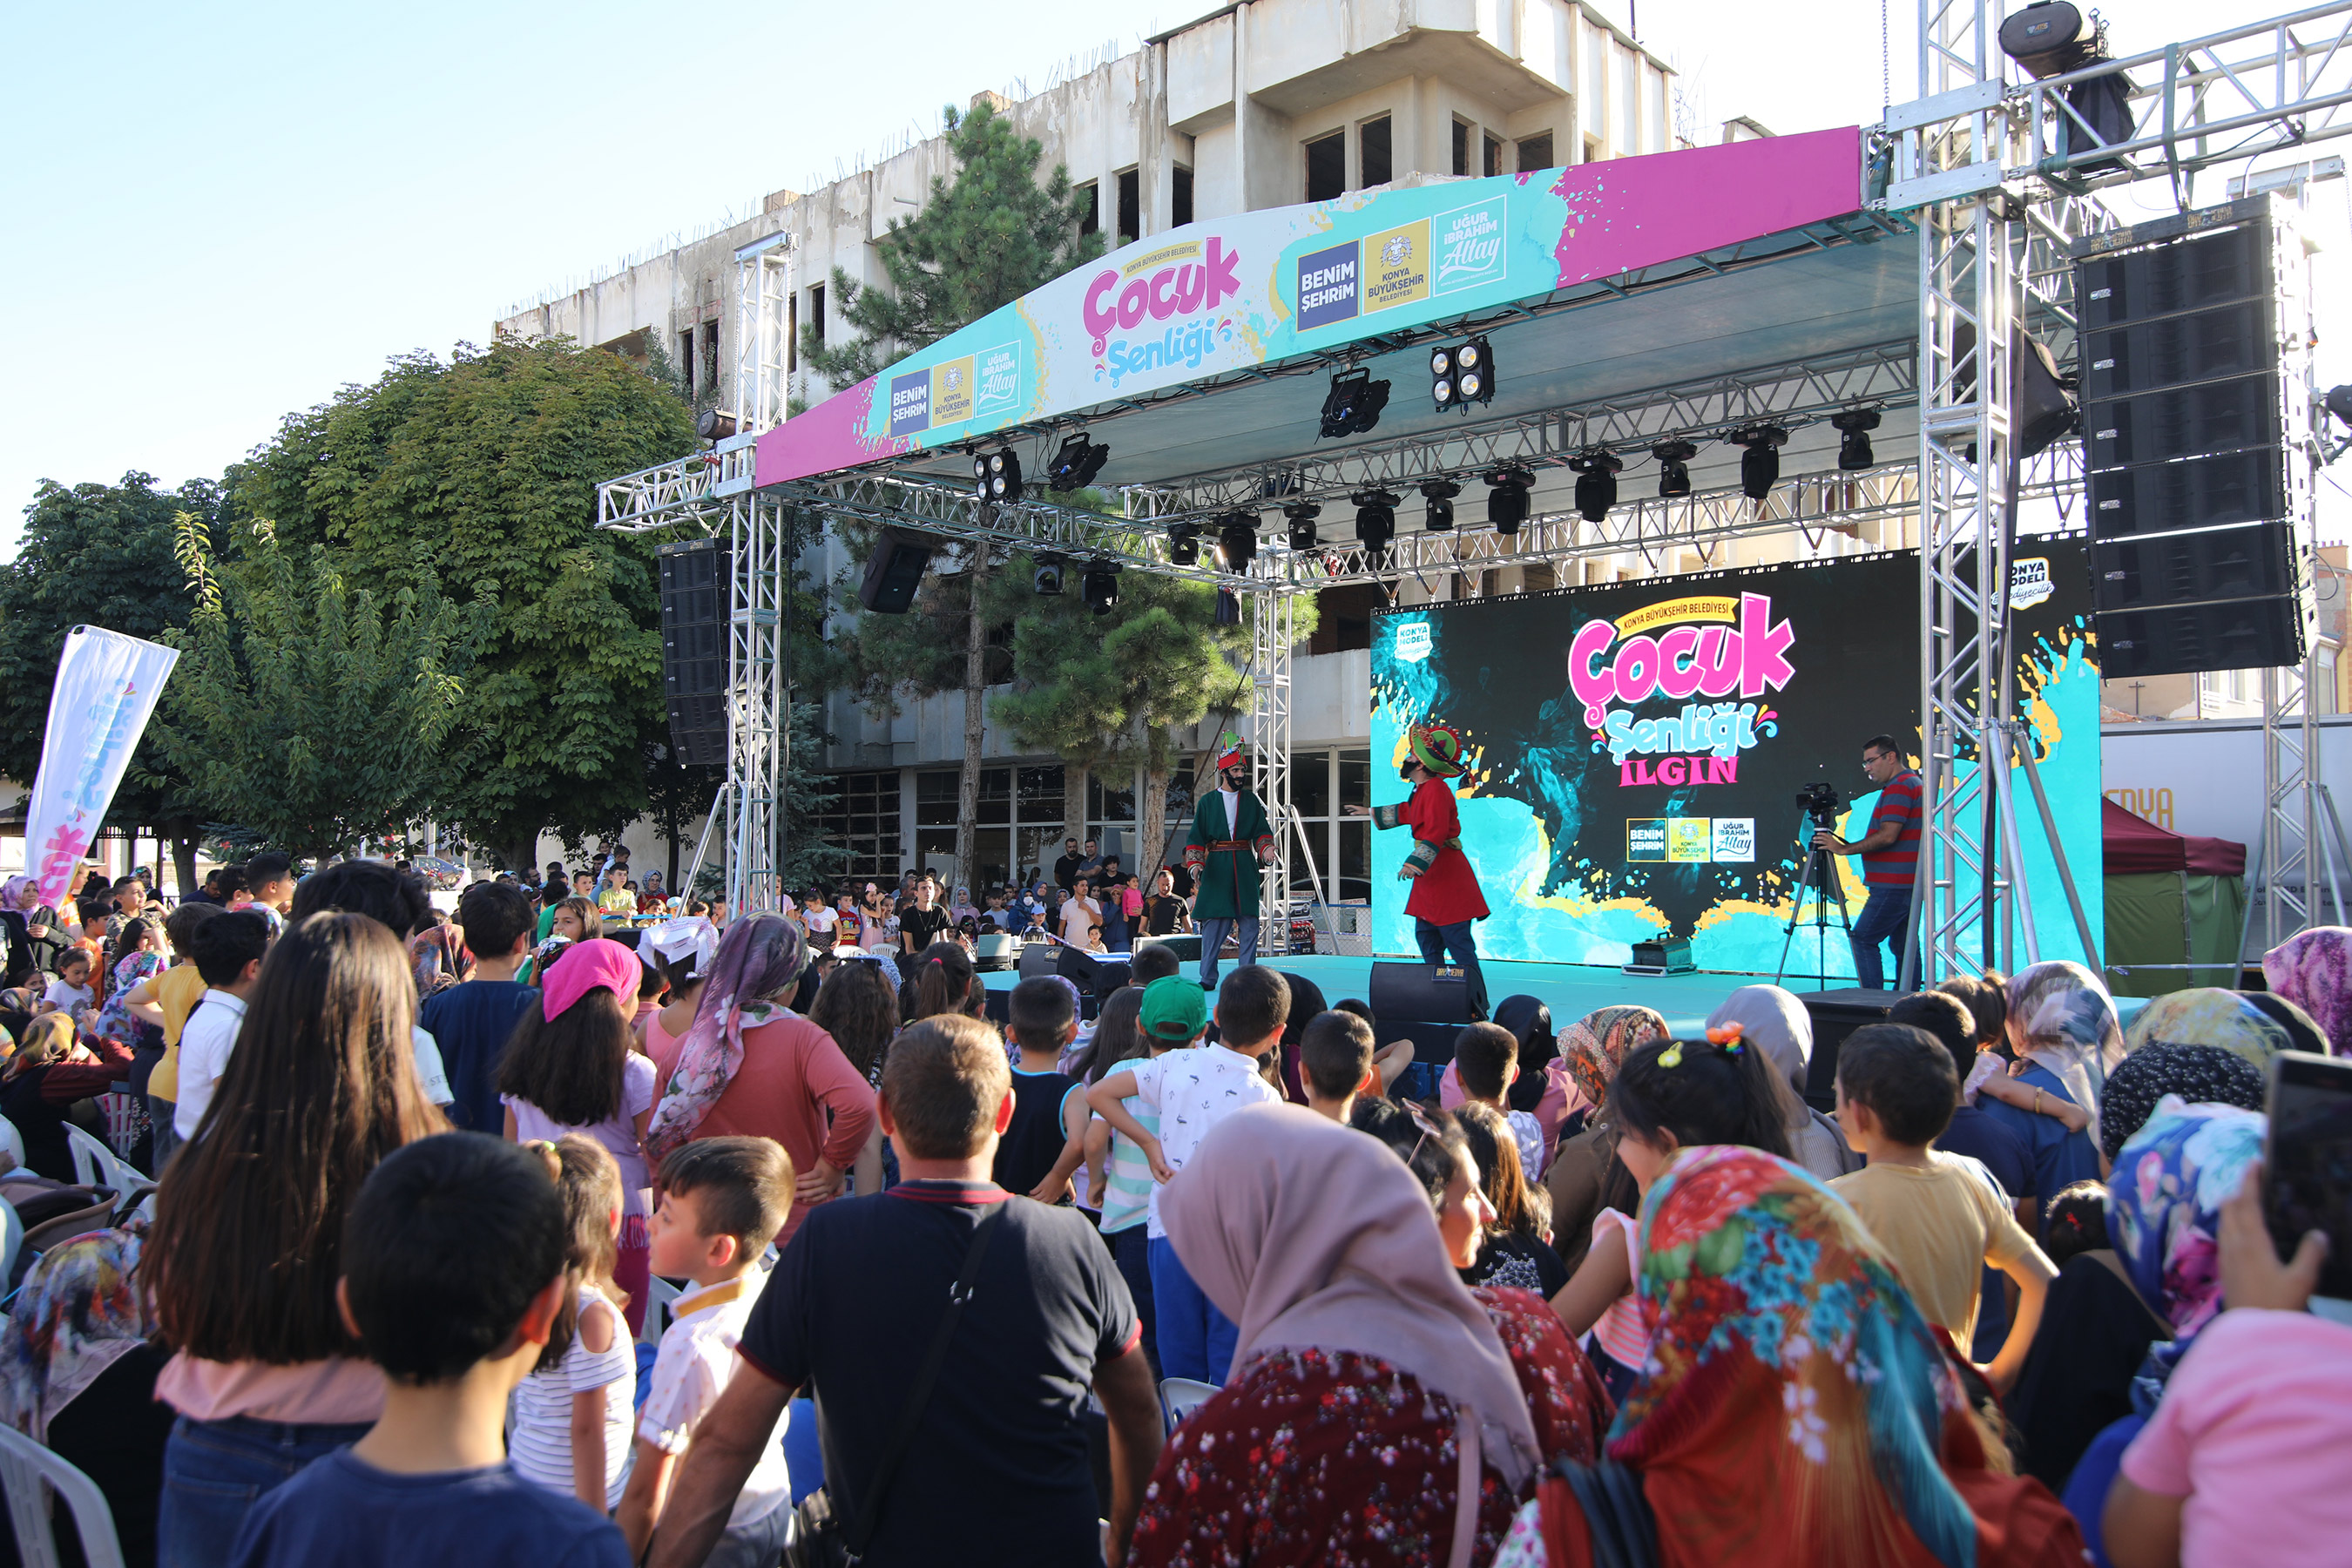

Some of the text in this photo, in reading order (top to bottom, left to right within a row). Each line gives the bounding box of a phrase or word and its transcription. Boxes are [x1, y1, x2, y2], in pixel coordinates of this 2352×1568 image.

[1452, 212, 1489, 231] UĞUR
[1126, 245, 1197, 274] KONYA BÜYÜKŞEHİR BELEDİYESİ
[1438, 237, 1502, 281] Altay
[1382, 267, 1410, 282] KONYA
[1368, 274, 1424, 298] BÜYÜKŞEHİR
[1379, 288, 1413, 303] BELEDİYESİ
[987, 352, 1010, 367] UĞUR
[1107, 317, 1217, 389] Şenliği
[943, 392, 962, 402] KONYA
[978, 373, 1017, 404] Altay
[935, 398, 970, 416] BÜYÜKŞEHİR
[2011, 562, 2045, 576] ONYA
[2011, 572, 2045, 586] ODELİ
[1624, 602, 1729, 630] KONYA BÜYÜKŞEHİR BELEDİYESİ
[1400, 625, 1428, 638] KONYA
[1605, 701, 1759, 767] Şenliği
[1619, 756, 1740, 787] ILGIN
[1715, 835, 1752, 855] Altay
